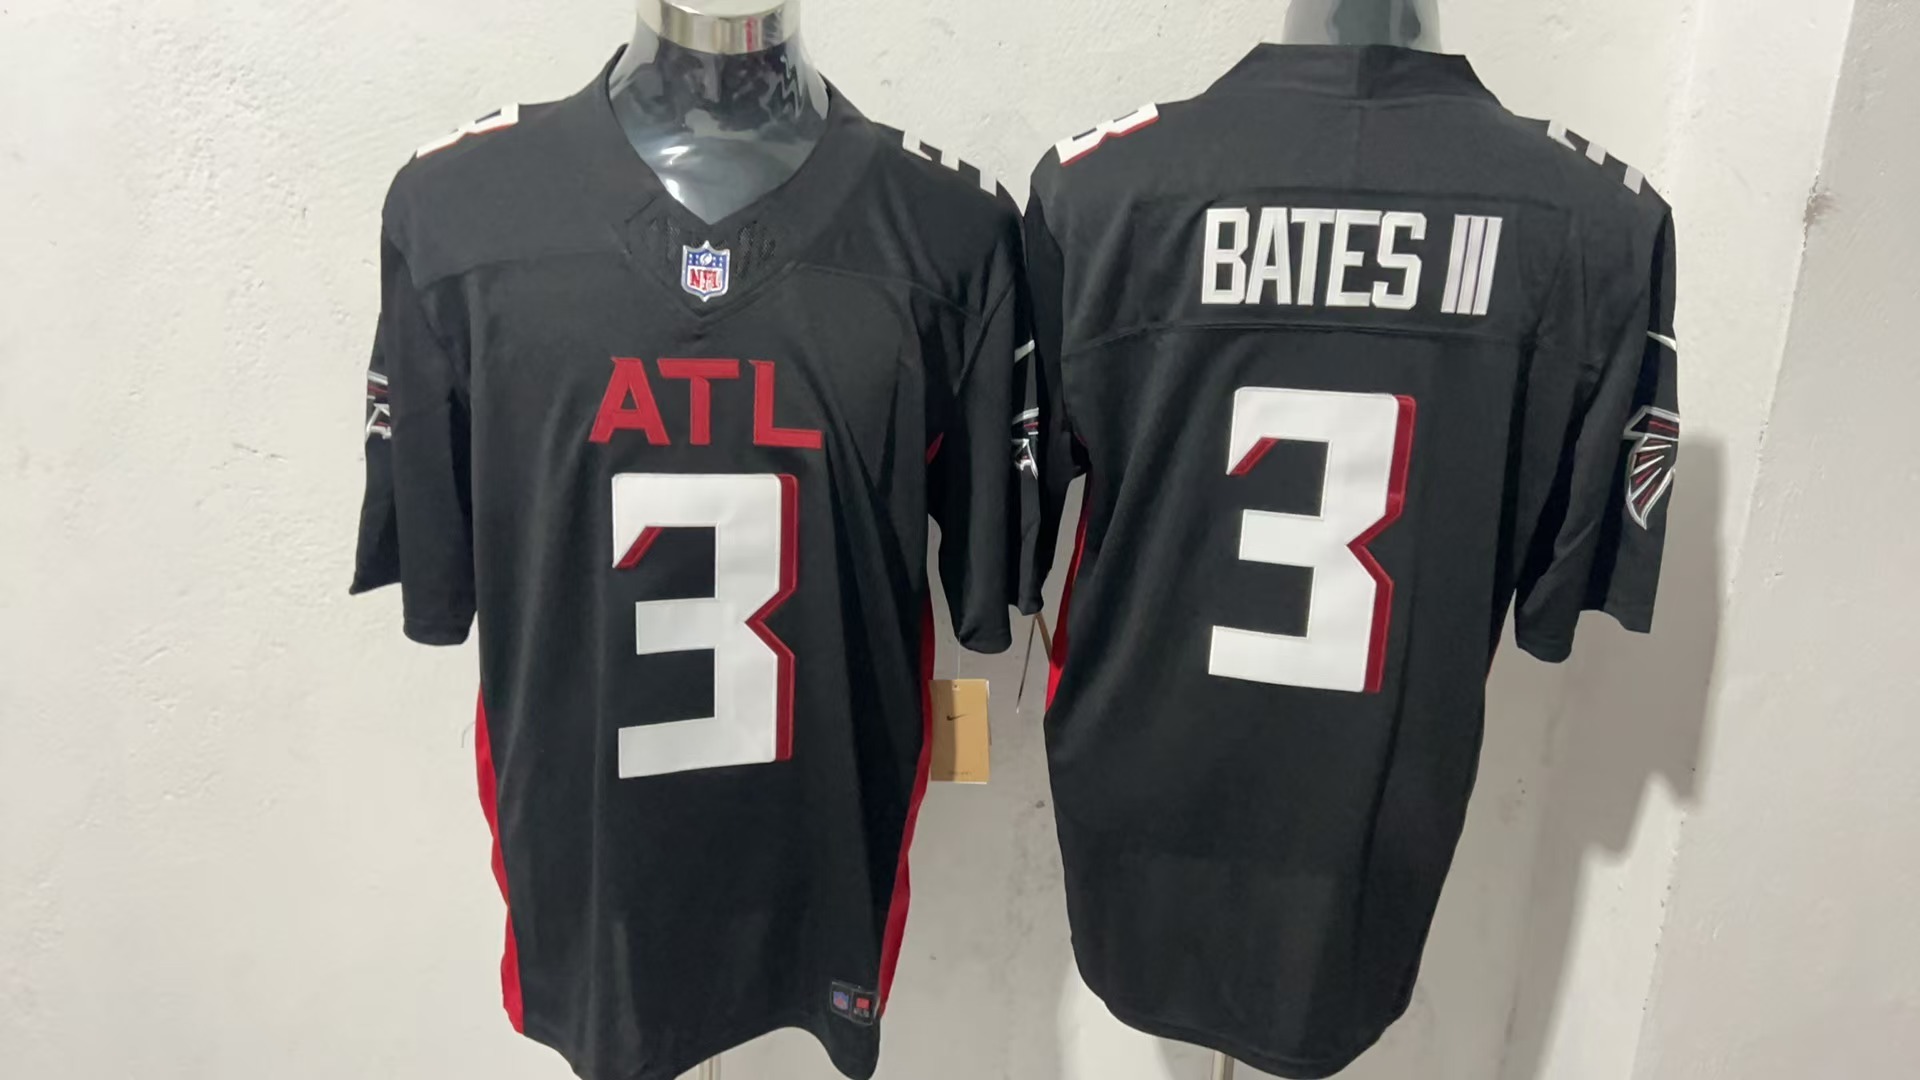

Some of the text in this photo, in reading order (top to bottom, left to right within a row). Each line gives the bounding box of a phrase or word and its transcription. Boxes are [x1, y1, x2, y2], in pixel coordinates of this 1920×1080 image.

[690, 268, 720, 290] NFL
[1201, 207, 1502, 315] BATES III
[589, 358, 822, 447] ATL
[1208, 388, 1415, 693] 3
[612, 474, 799, 778] 3
